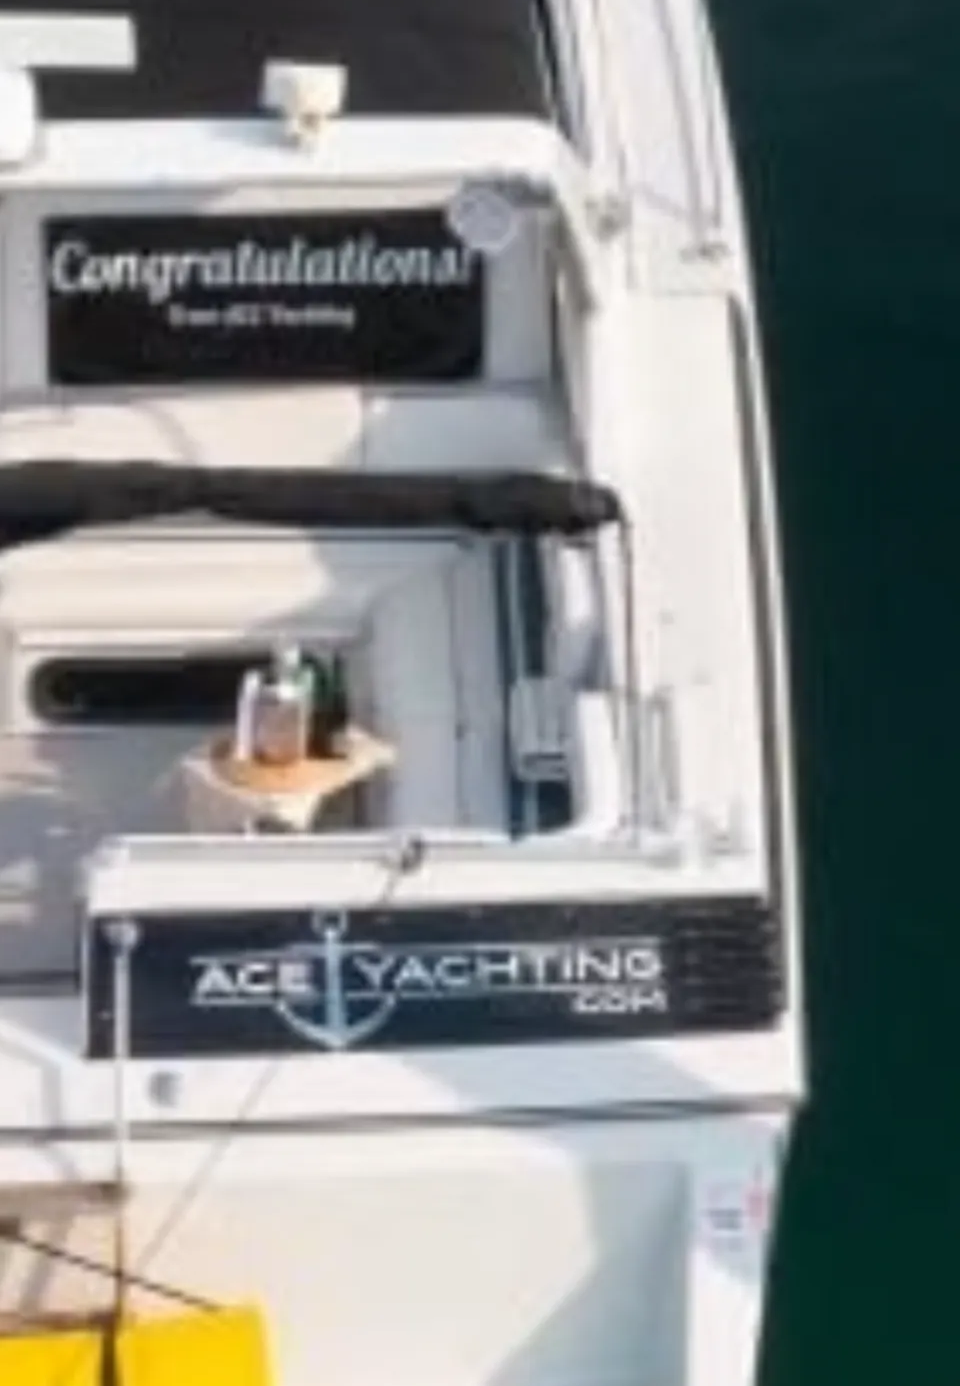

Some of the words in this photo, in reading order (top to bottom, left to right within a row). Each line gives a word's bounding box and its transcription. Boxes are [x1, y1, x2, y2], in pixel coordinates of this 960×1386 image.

[51, 232, 471, 302] Congratulations!
[194, 961, 312, 995] ACE
[351, 941, 663, 990] YACHTING
